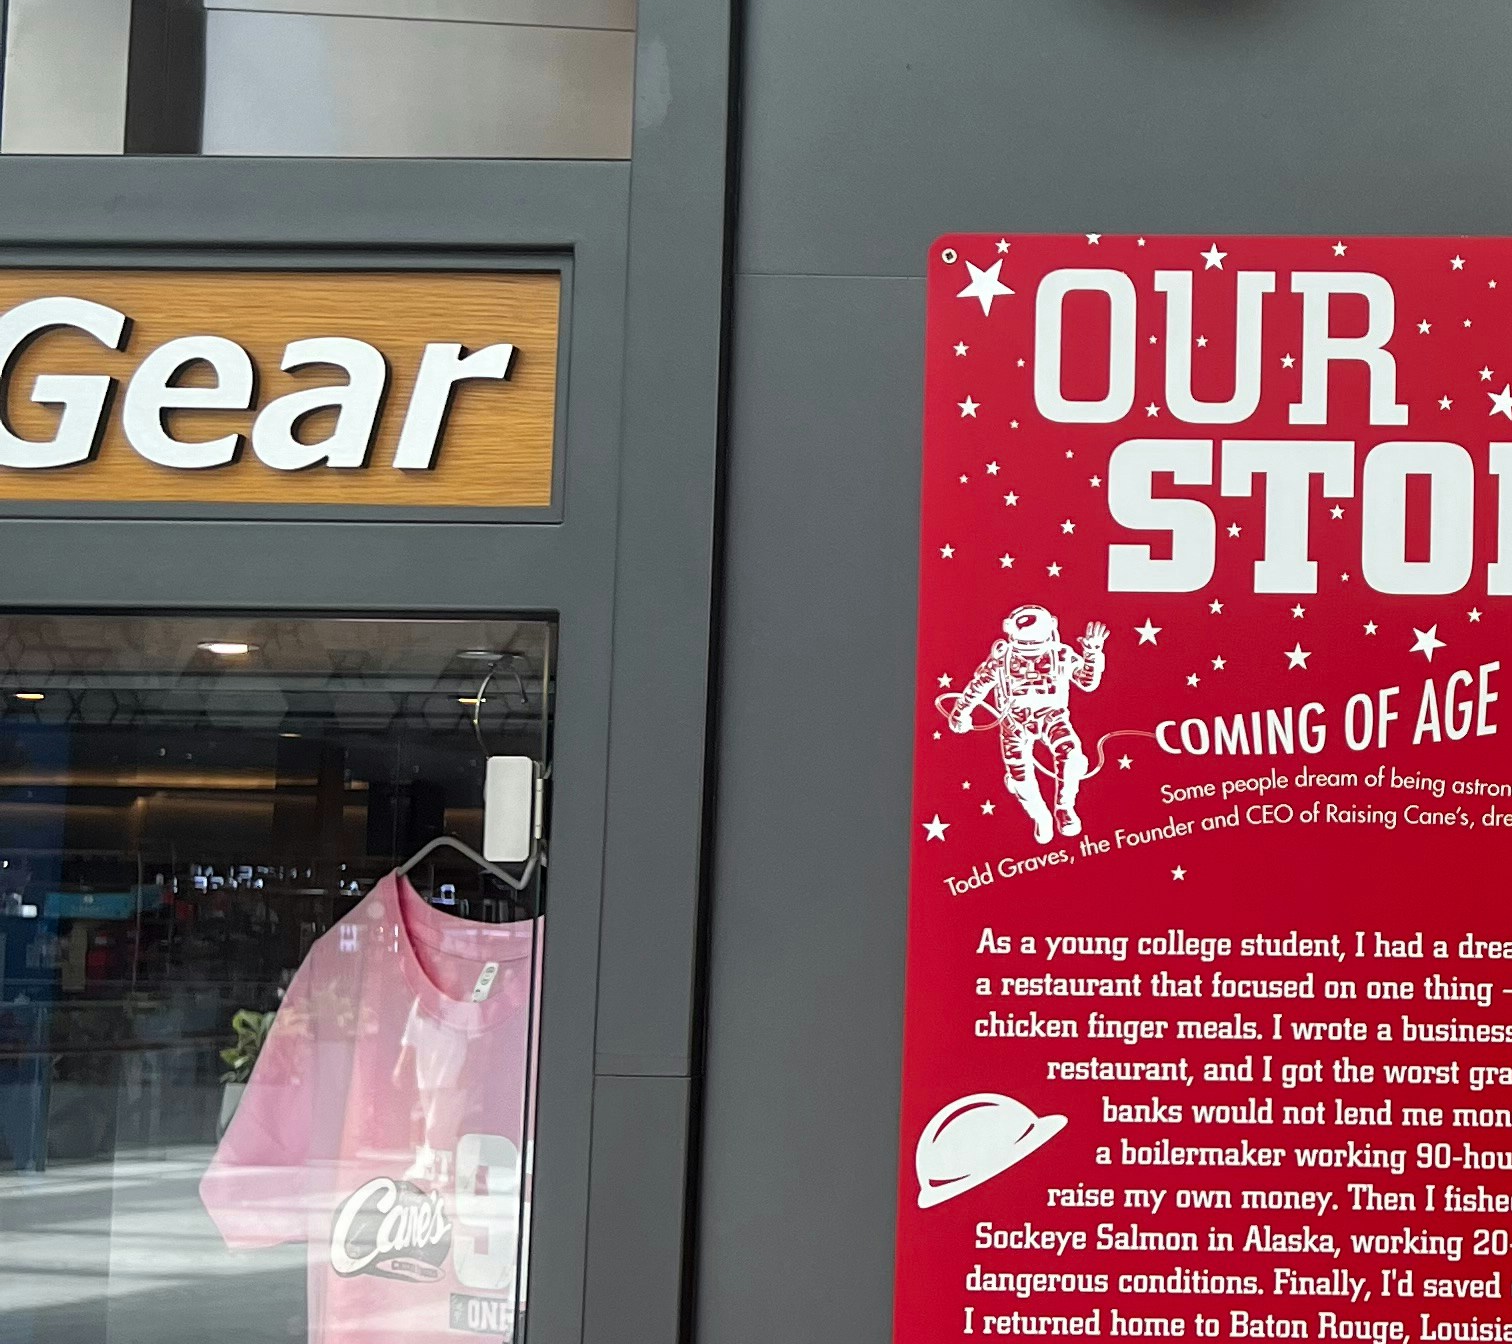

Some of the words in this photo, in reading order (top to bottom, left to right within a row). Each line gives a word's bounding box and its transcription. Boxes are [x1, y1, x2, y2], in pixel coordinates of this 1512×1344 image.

[1034, 269, 1409, 426] OUR
[0, 296, 519, 472] Gear
[1156, 702, 1326, 755] COMING
[1345, 686, 1399, 752] OF
[1413, 661, 1501, 745] AGE
[1160, 783, 1216, 804] Some
[1221, 767, 1289, 801] people
[1294, 765, 1358, 788] dream
[1364, 764, 1386, 788] of
[1390, 766, 1446, 799] being
[943, 861, 995, 897] Todd
[997, 849, 1075, 878] Graves,
[1079, 834, 1111, 857] the
[1114, 815, 1195, 849] Founder
[1200, 804, 1240, 831] and
[1245, 803, 1294, 825] CEO
[1299, 800, 1321, 824] of
[1326, 803, 1397, 830] Raising
[1403, 804, 1475, 830] Cane’s,
[975, 927, 1012, 954] As
[1020, 936, 1037, 955] a
[1044, 936, 1129, 962] young
[1137, 928, 1232, 963] college
[1240, 930, 1346, 963] student,
[1354, 931, 1366, 958] I
[1373, 931, 1424, 959] had
[1432, 940, 1450, 959] a
[1095, 1146, 1113, 1165] a
[1120, 1137, 1287, 1167] boilermaker
[1293, 1140, 1407, 1175] working
[332, 1176, 452, 1274] Cane's
[975, 1221, 1087, 1257] Sockeye
[1096, 1222, 1199, 1252] Salmon
[1207, 1226, 1235, 1252] in
[1242, 1224, 1341, 1259] Alaska,
[1349, 1226, 1464, 1262] working
[965, 1263, 1109, 1299] dangerous
[1118, 1266, 1264, 1295] conditions.
[1272, 1267, 1372, 1303] Finally,
[1380, 1268, 1415, 1297] I'd
[1423, 1271, 1502, 1299] saved
